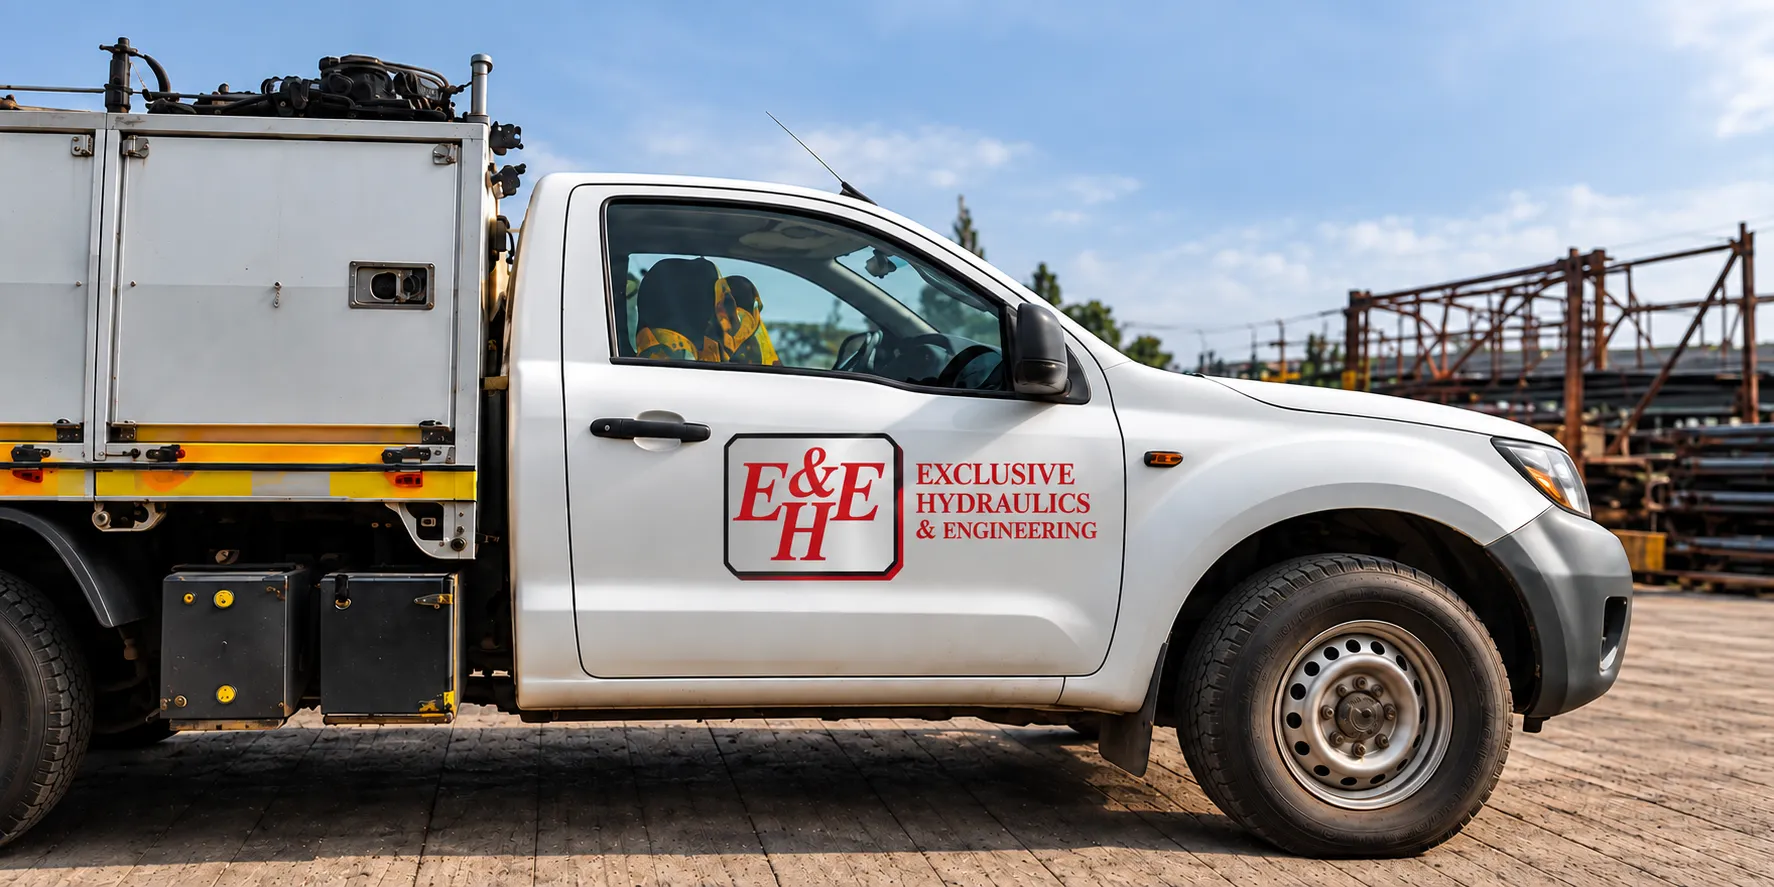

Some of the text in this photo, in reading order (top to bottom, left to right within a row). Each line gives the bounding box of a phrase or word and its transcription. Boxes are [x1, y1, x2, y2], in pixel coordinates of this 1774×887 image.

[916, 463, 1075, 486] EXCLUSIVE
[916, 493, 1091, 514] HYDRAULICS
[916, 520, 1097, 539] & ENGINEERING
